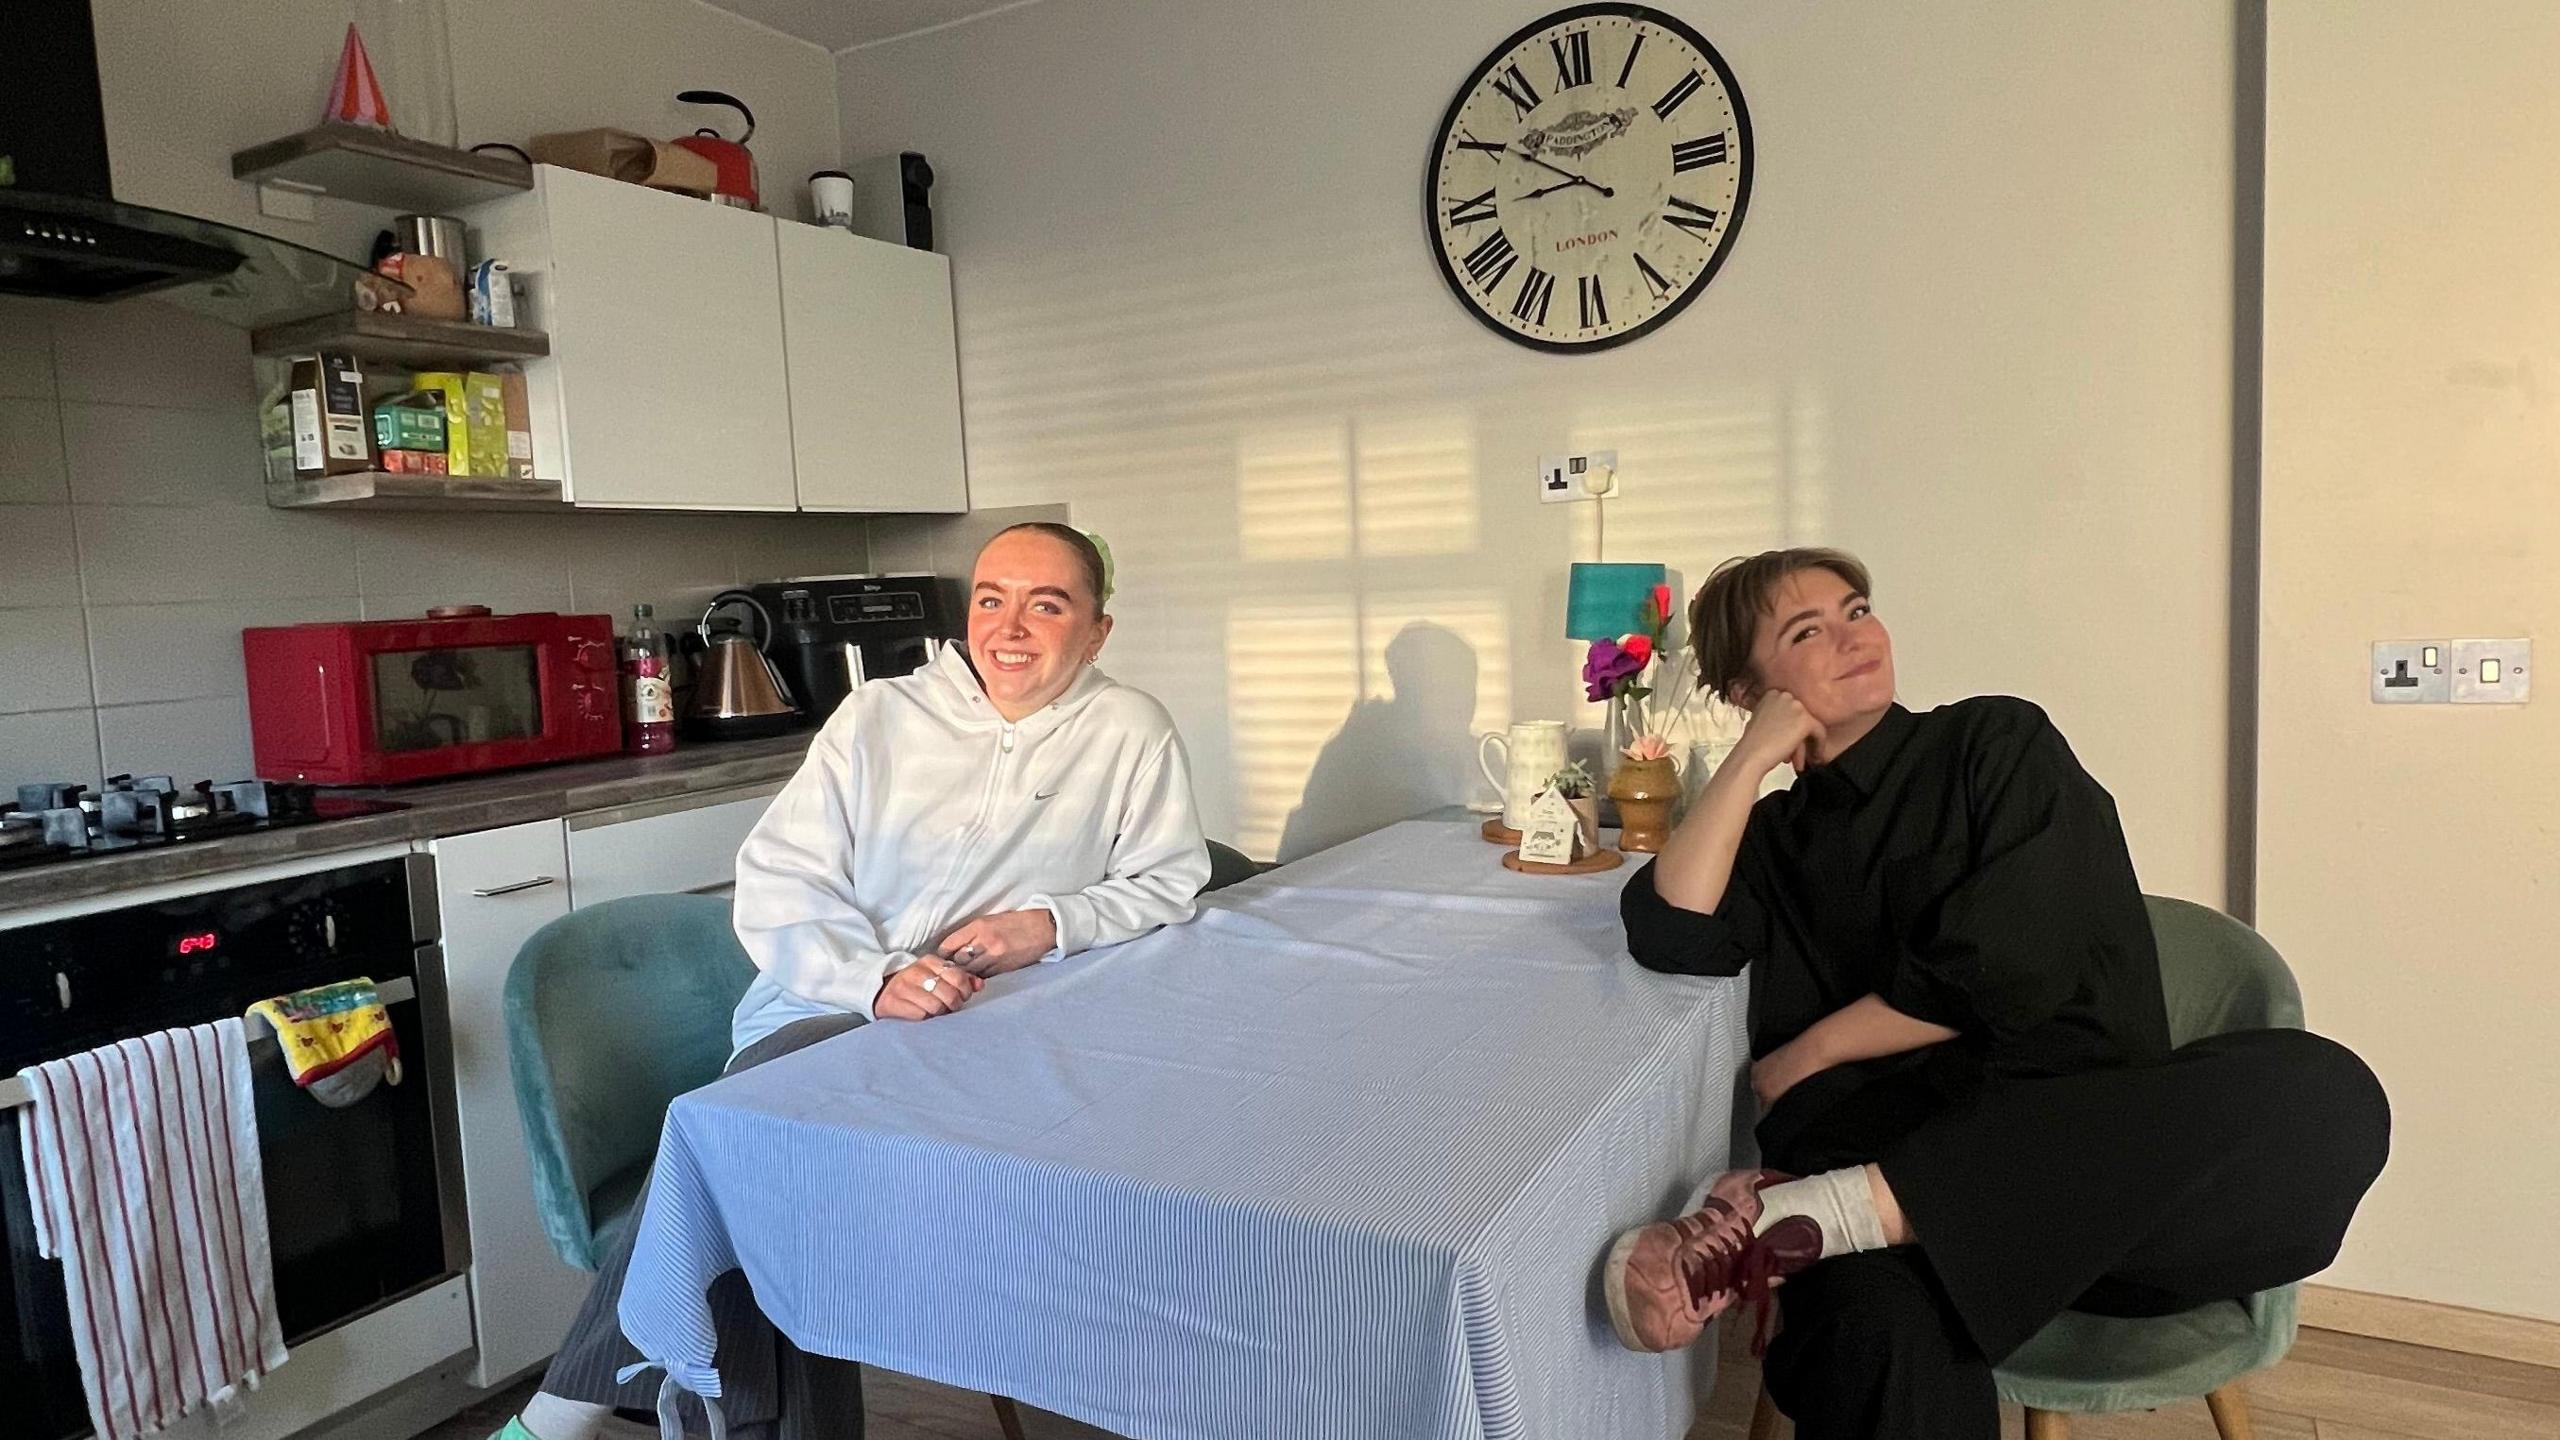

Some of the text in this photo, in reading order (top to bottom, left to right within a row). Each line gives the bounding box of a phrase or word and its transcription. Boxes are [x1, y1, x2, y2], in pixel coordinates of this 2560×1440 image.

[1550, 30, 1593, 94] XII
[1493, 63, 1543, 123] XI
[1545, 121, 1610, 147] PADDINGTON
[1671, 132, 1727, 175] III
[1555, 229, 1619, 253] LONDON
